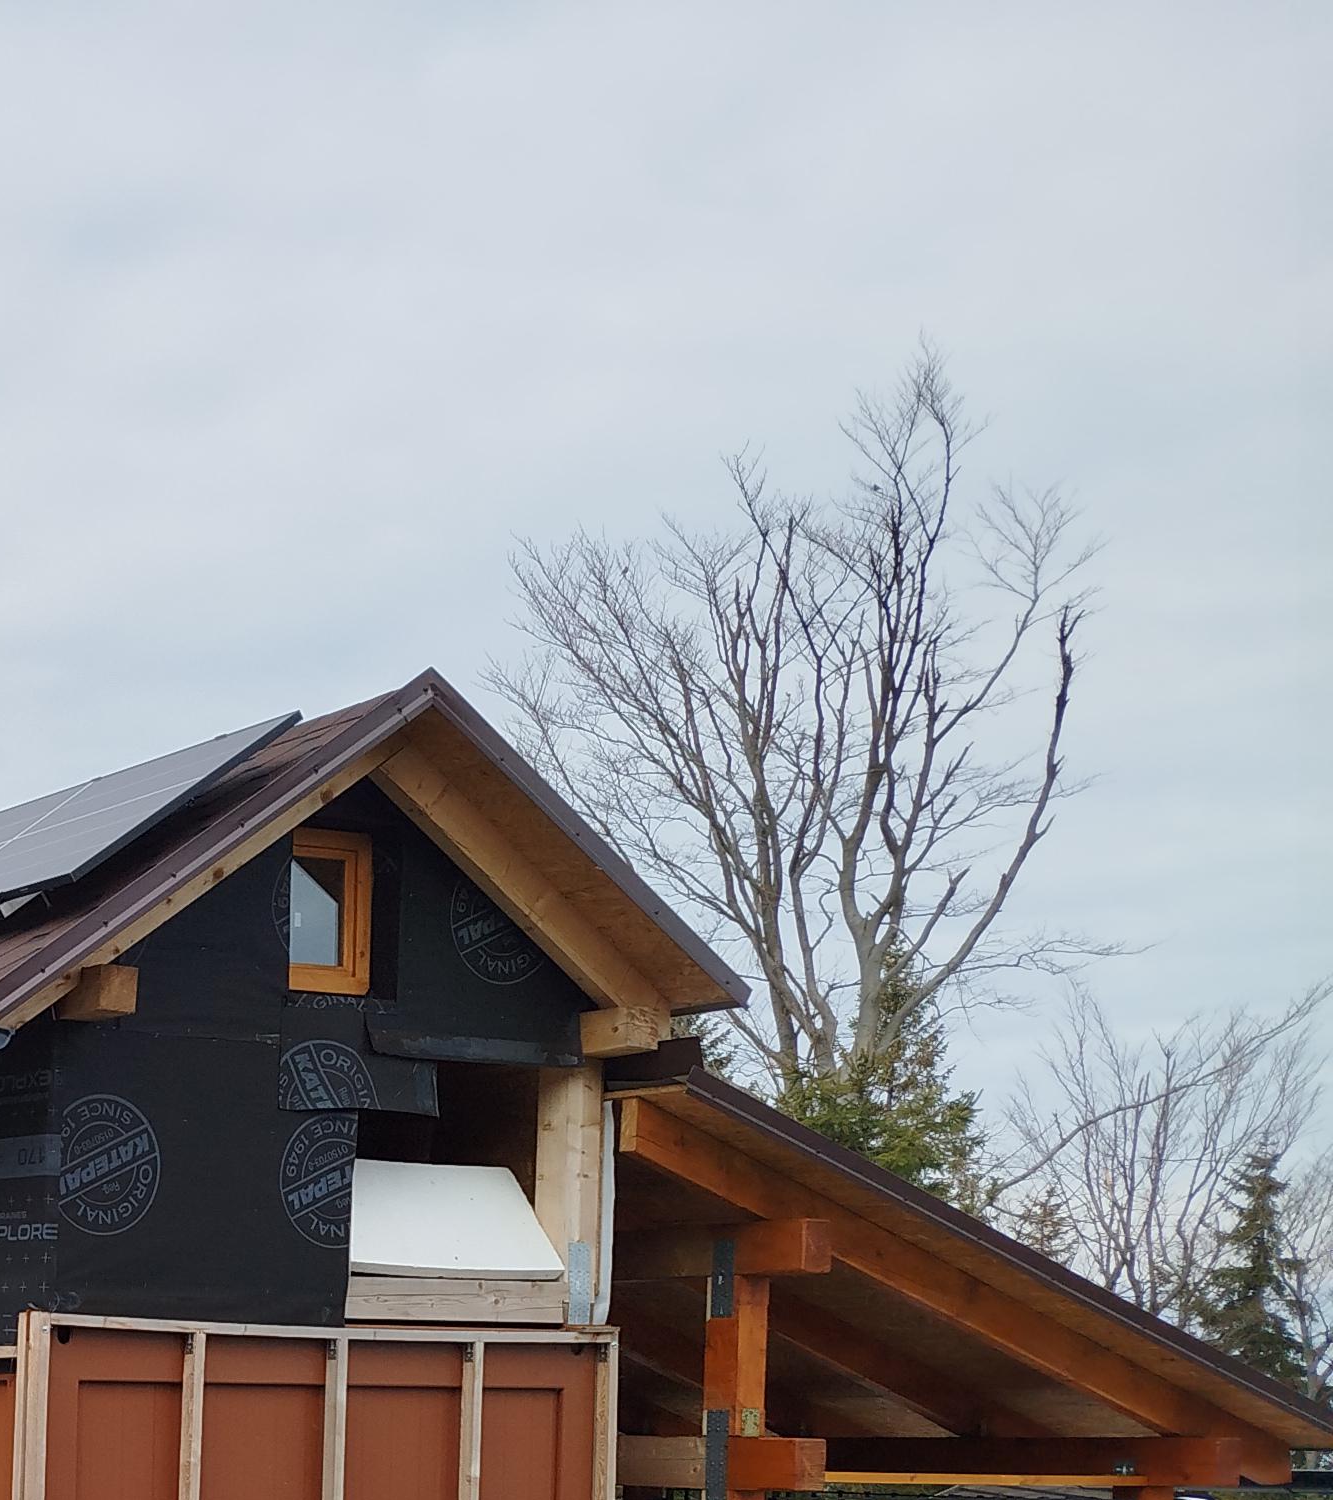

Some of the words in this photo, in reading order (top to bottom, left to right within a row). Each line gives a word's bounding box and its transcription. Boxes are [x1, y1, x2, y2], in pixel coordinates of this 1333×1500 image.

[477, 950, 531, 975] GINAL
[294, 1053, 335, 1108] KATE
[320, 1049, 371, 1108] ORIGIN
[310, 1119, 357, 1138] INCE
[76, 1165, 153, 1225] ORIGINAL
[287, 1164, 352, 1209] TEPAL
